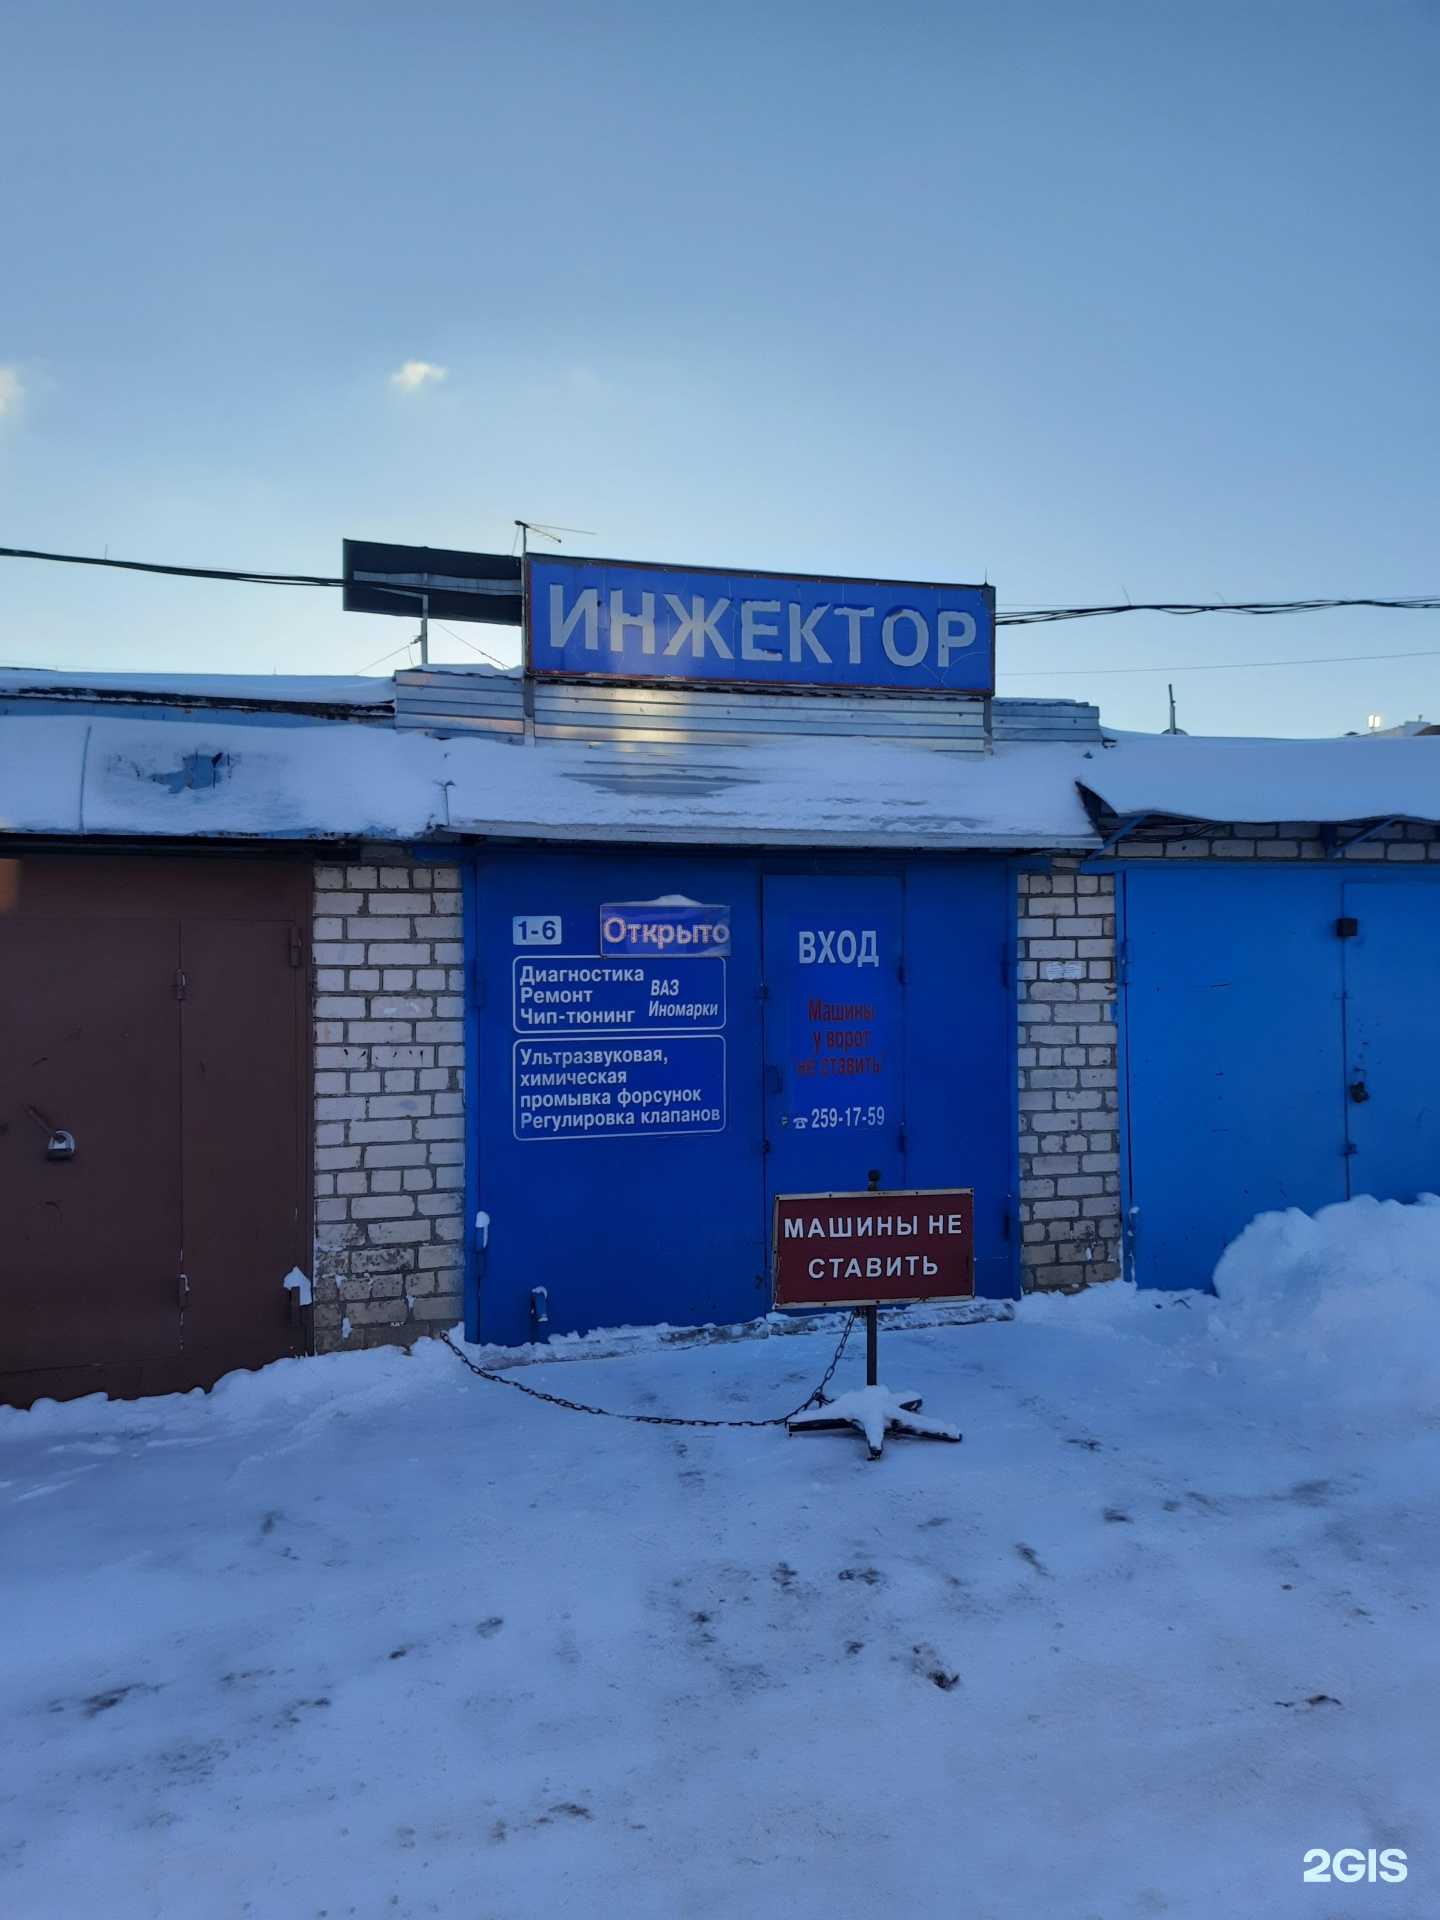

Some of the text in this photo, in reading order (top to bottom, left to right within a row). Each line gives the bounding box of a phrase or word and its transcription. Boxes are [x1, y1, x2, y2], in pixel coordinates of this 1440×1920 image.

[548, 583, 978, 668] ИНЖЕКТОР
[517, 920, 557, 941] 1-6
[602, 917, 730, 949] Открыто
[798, 930, 880, 967] ВХОД
[519, 965, 645, 986] Диагностика
[520, 987, 593, 1004] Ремонт
[650, 979, 680, 996] ВАЗ
[520, 1008, 636, 1025] Чип-тюнинг
[648, 1001, 719, 1019] Иномарки
[808, 998, 875, 1021] Машины
[519, 1048, 669, 1068] Ультразвуковая,
[520, 1071, 628, 1087] химическая
[520, 1087, 702, 1111] промывка форсунок
[520, 1108, 721, 1132] Регулировка клапанов
[811, 1106, 885, 1129] 259-17-59
[783, 1214, 963, 1239] МАШИНЫ НЕ
[808, 1255, 939, 1279] СТАВИТЬ
